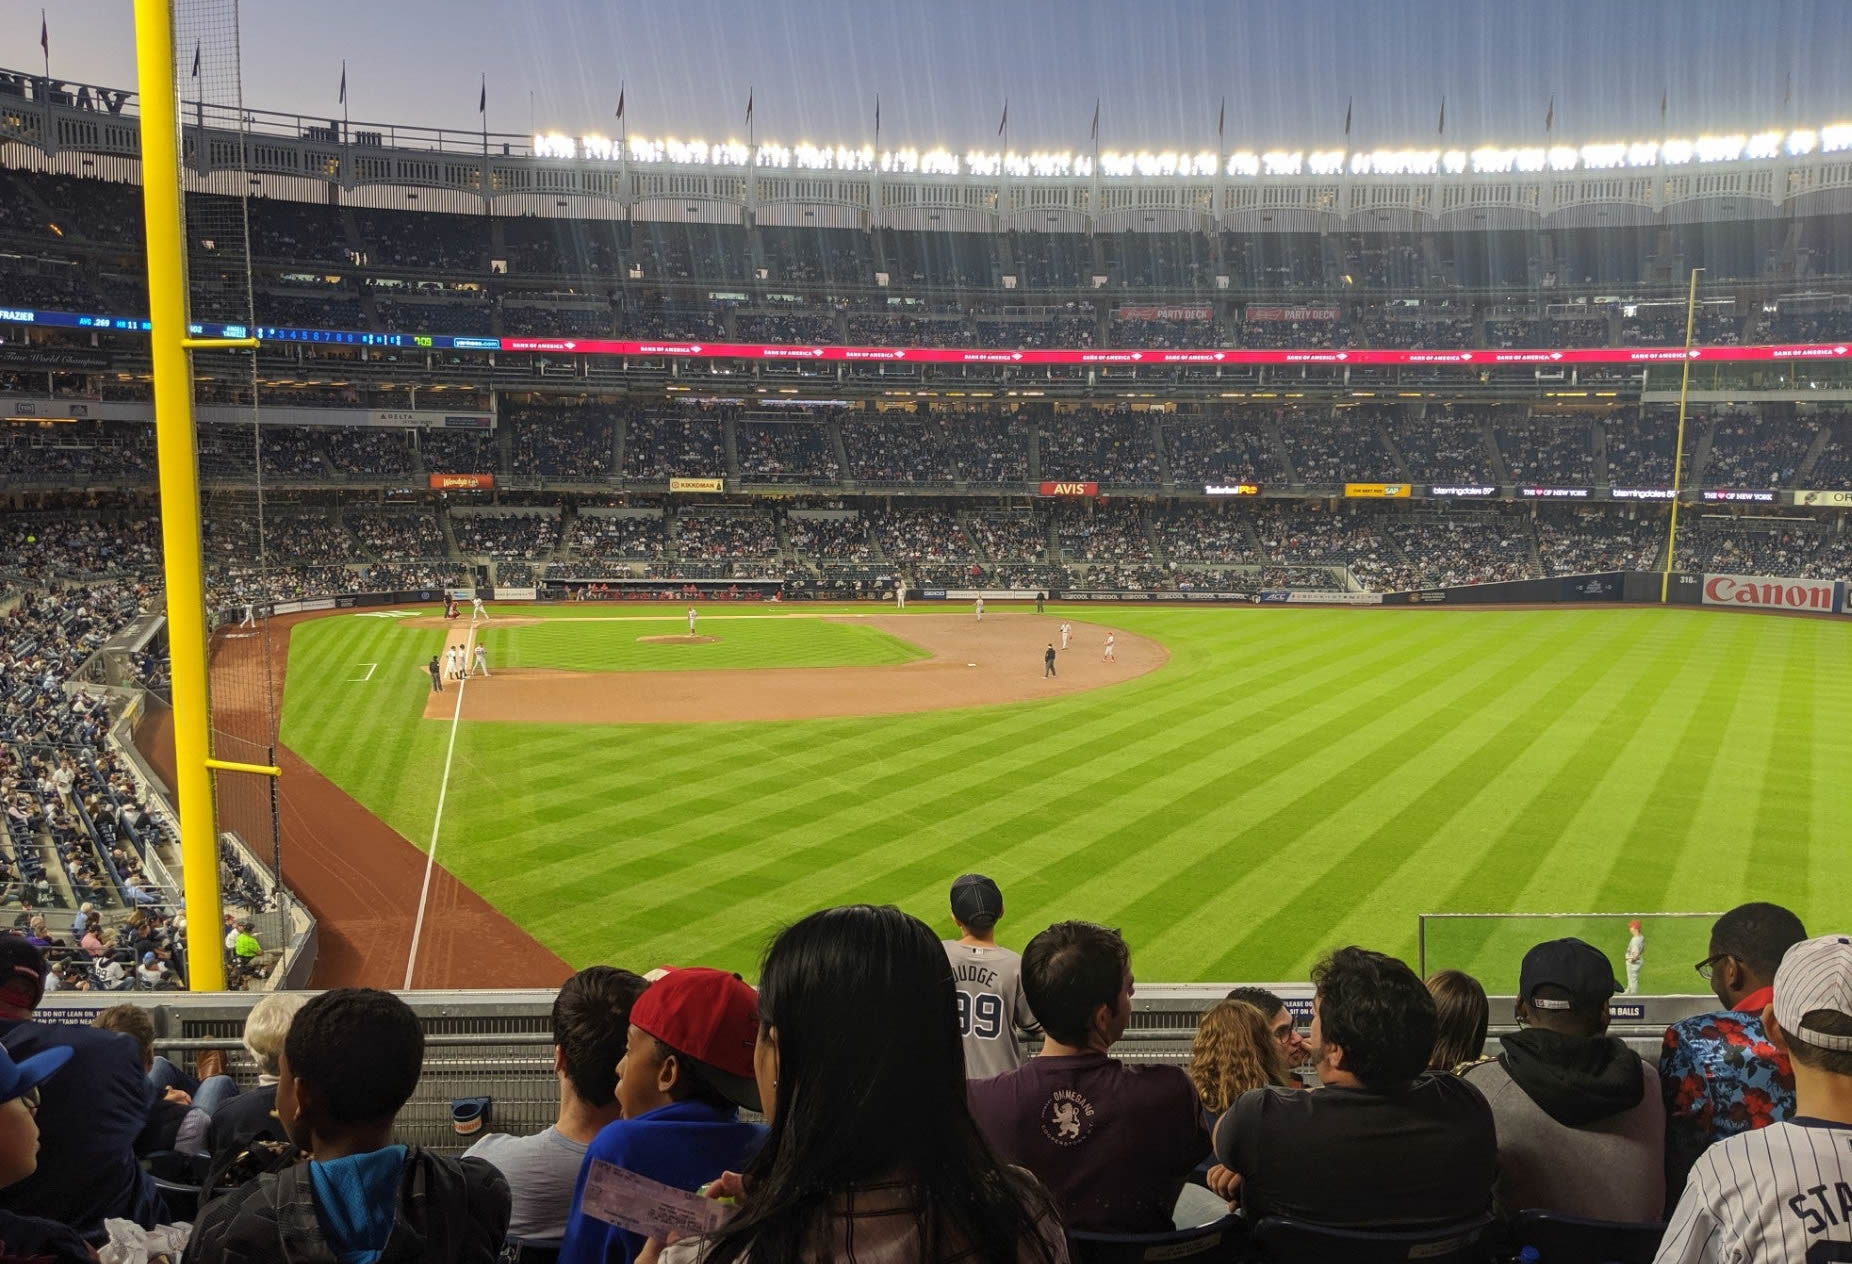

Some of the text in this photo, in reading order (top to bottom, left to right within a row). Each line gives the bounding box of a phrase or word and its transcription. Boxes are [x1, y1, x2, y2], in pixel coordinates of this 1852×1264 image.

[1157, 310, 1183, 318] PARTY
[1185, 310, 1207, 318] DECK
[1285, 310, 1310, 319] PARTY
[1312, 310, 1334, 318] DECK
[1054, 484, 1084, 494] AVIS
[1705, 577, 1831, 608] Canon
